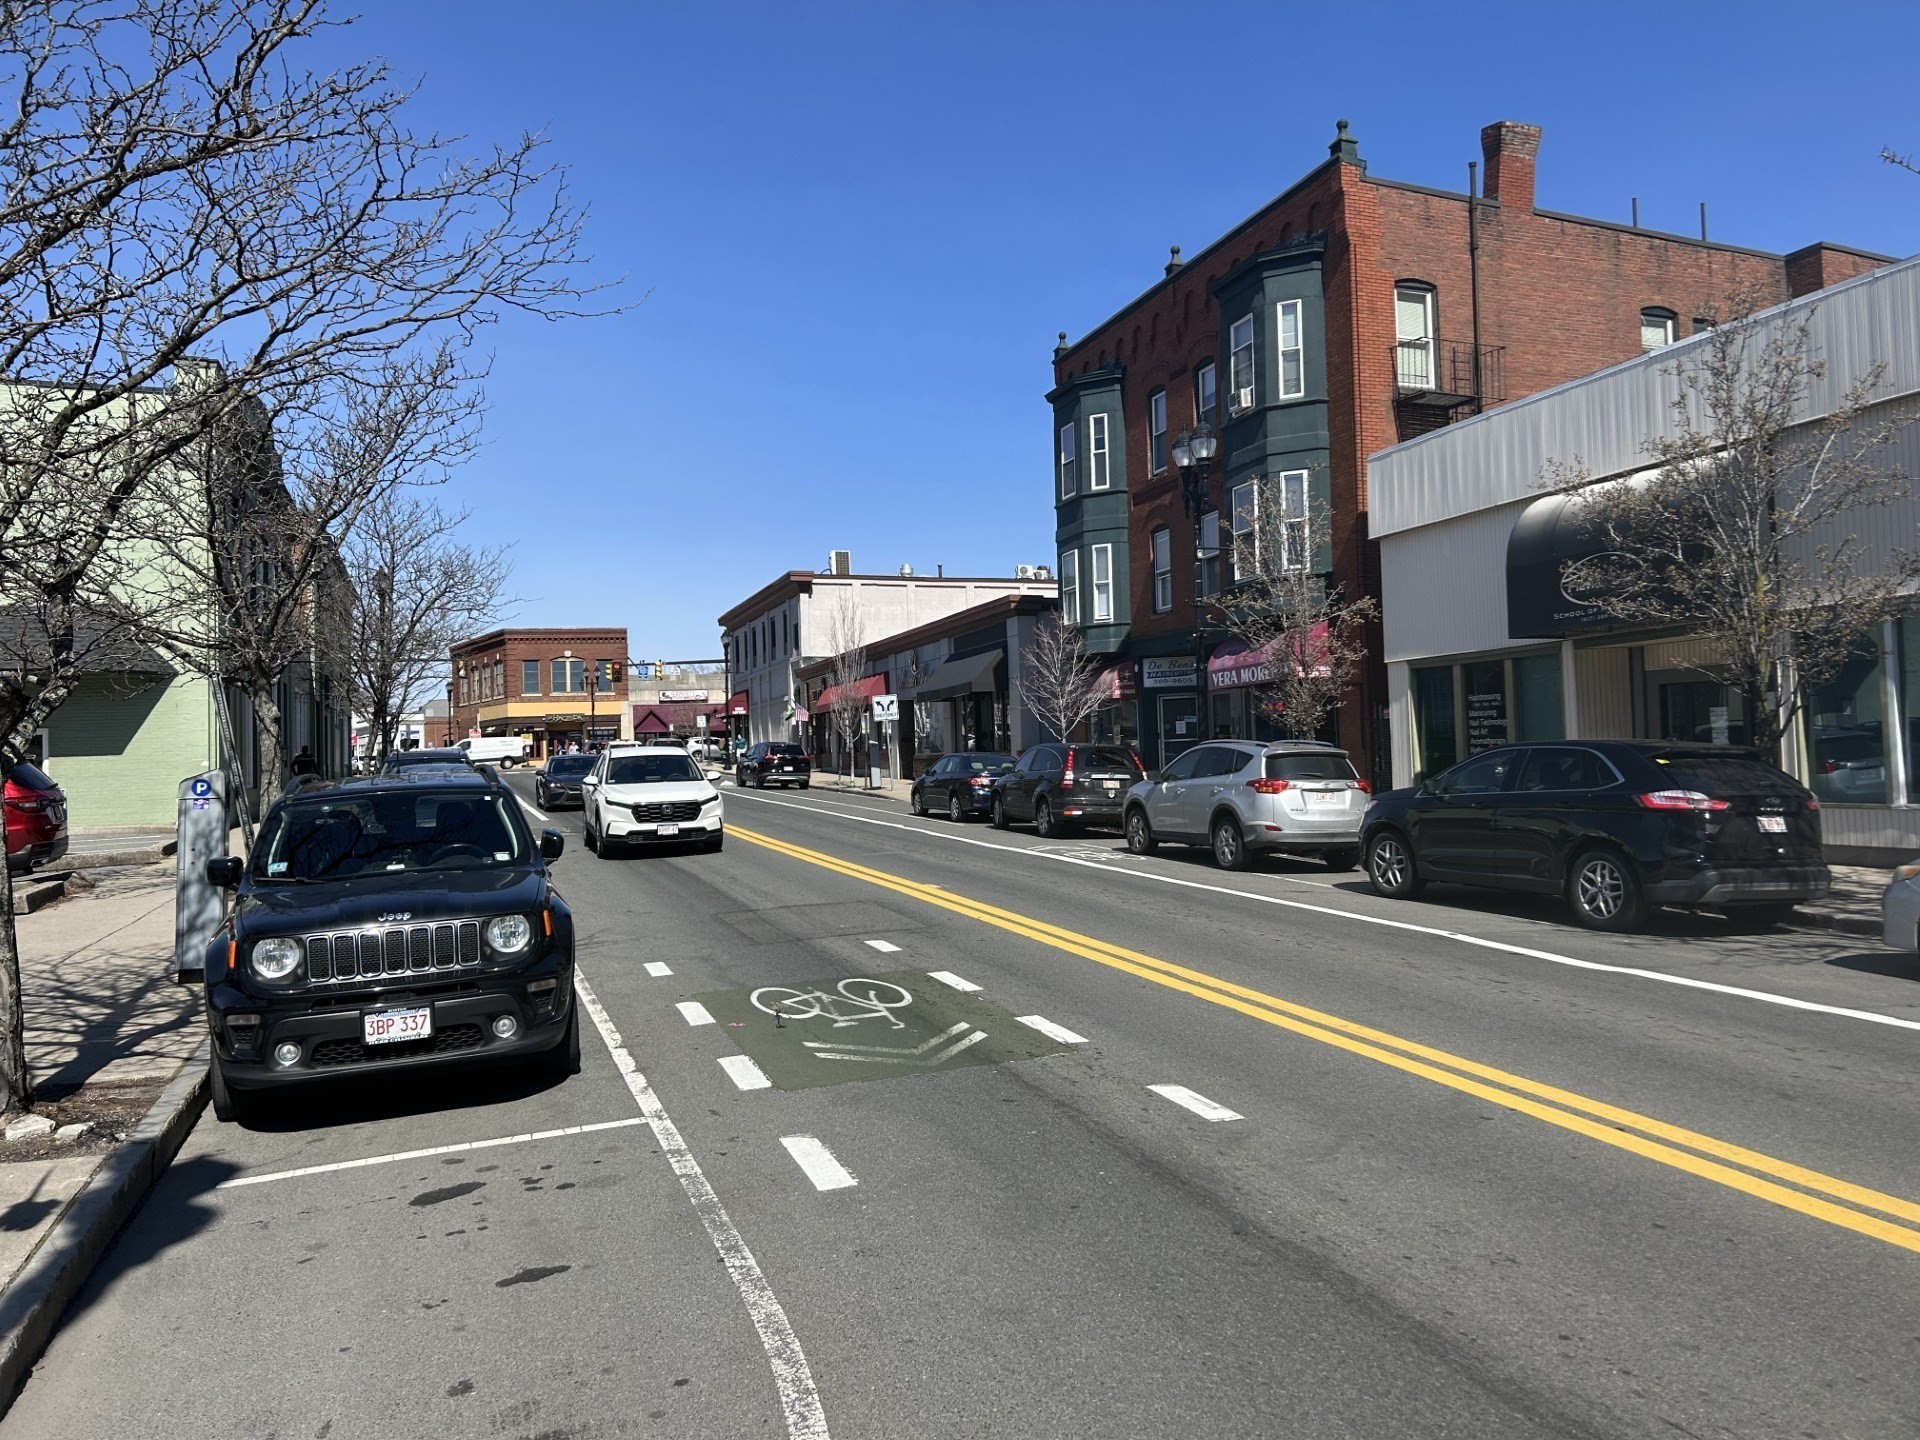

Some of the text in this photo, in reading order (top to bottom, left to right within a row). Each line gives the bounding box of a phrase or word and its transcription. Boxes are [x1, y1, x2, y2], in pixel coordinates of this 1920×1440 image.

[1553, 610, 1586, 620] SCHOOL
[1149, 669, 1196, 678] HAIRCUTTING
[1211, 670, 1238, 687] VERA
[1468, 693, 1501, 702] Hairdressing
[1468, 710, 1497, 718] Manicuring
[1469, 719, 1480, 727] Nail
[1469, 727, 1489, 736] Nail Art
[196, 782, 208, 794] P
[378, 911, 412, 922] Jeep
[366, 1018, 395, 1037] 3BP
[399, 1014, 428, 1033] 337
